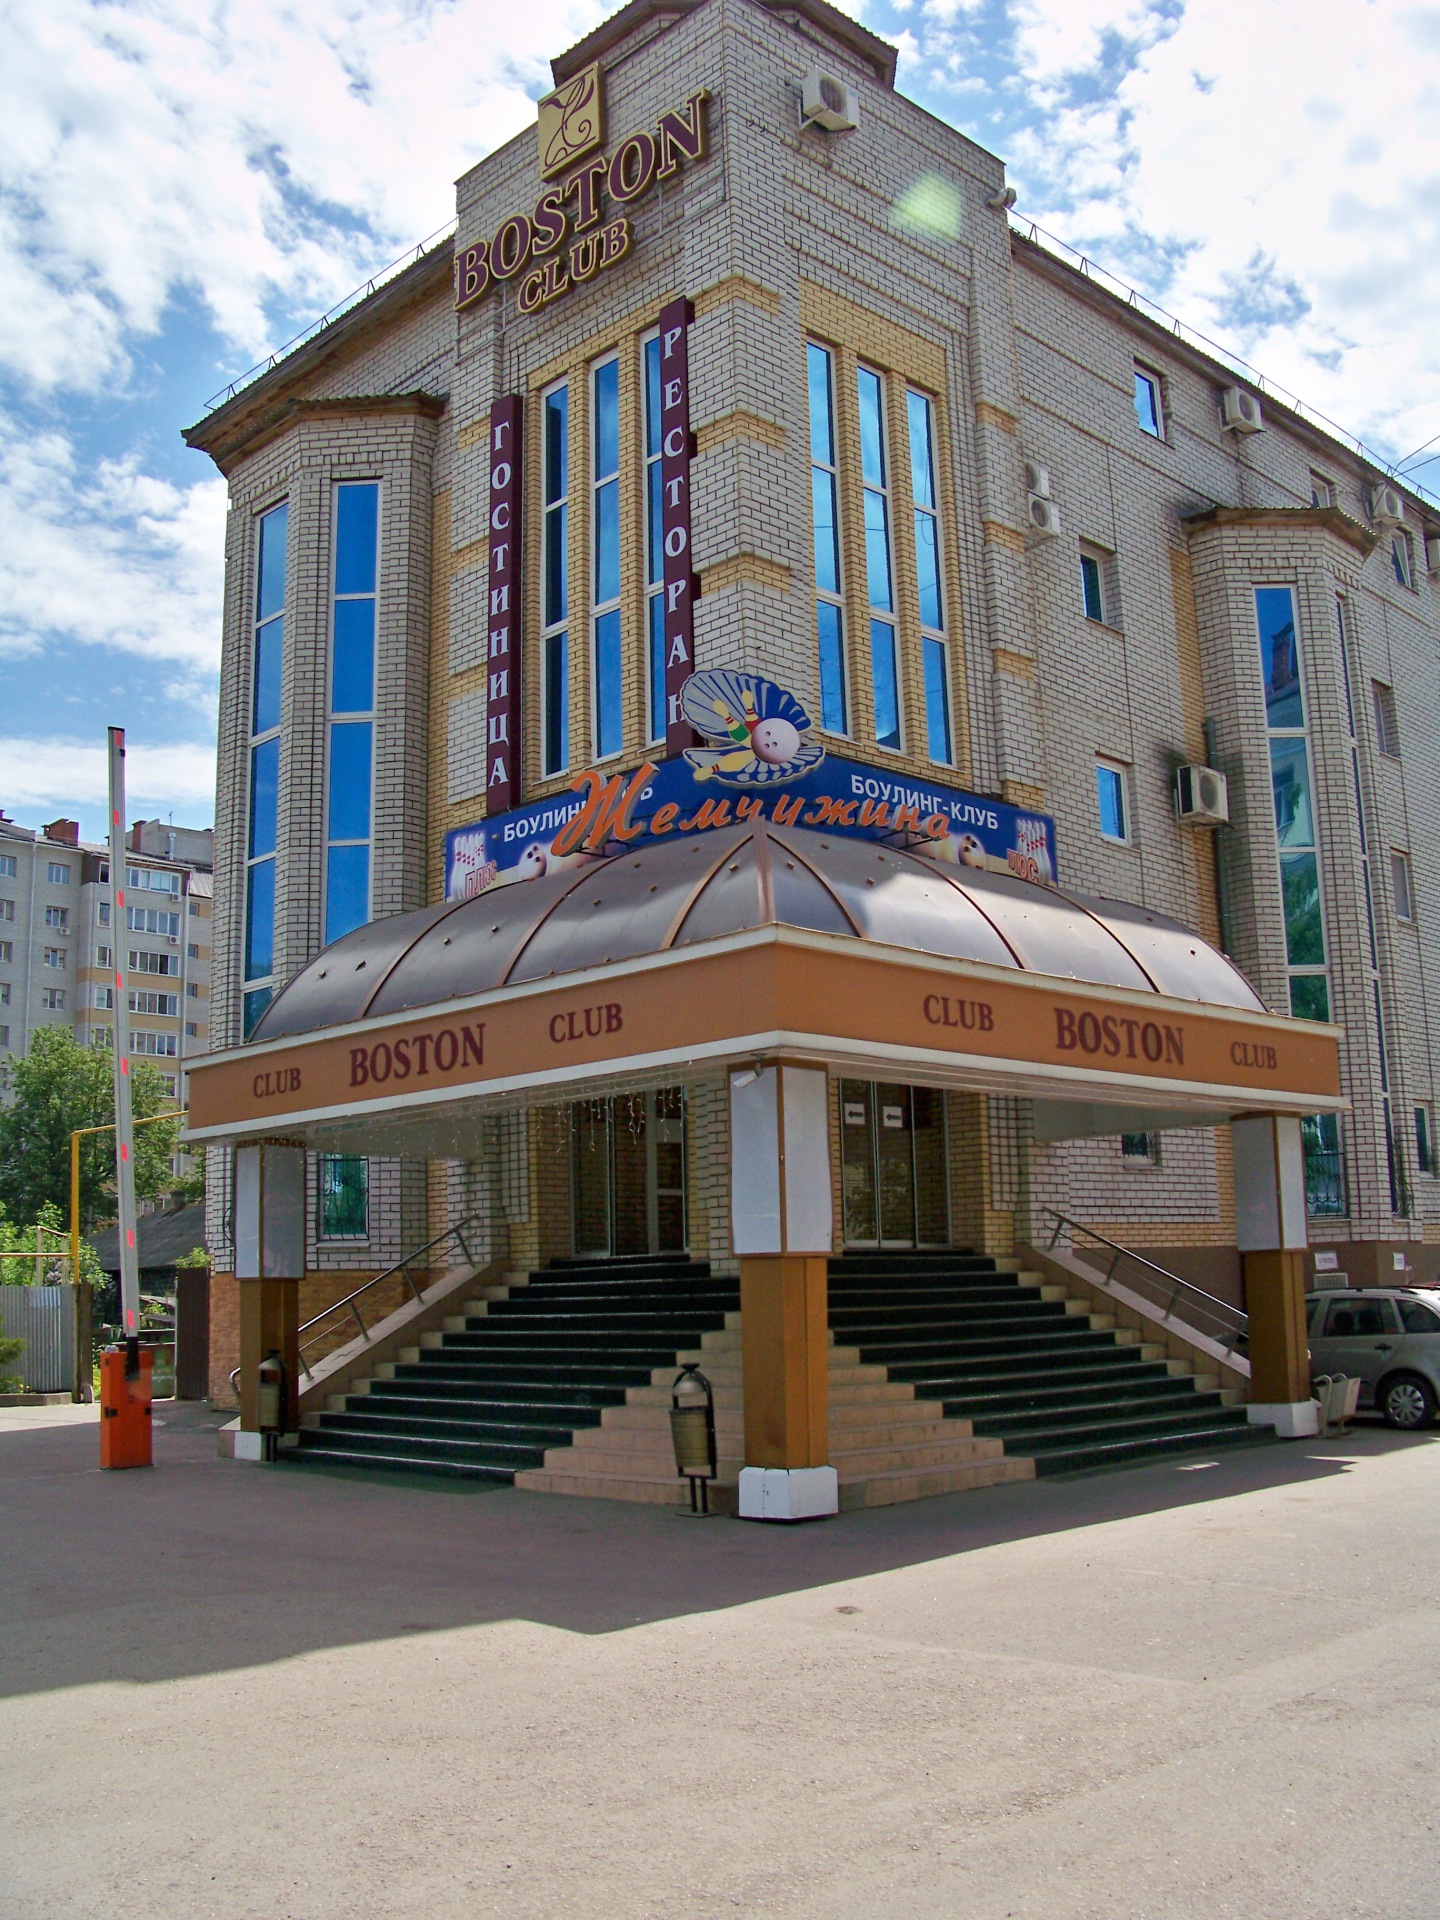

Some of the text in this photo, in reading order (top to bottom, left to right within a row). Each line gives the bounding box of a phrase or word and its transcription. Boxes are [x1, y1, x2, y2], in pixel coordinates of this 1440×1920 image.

[453, 88, 711, 312] BOSTON
[517, 217, 633, 314] CLUB
[487, 421, 512, 788] ГОСТИНИЦА
[851, 774, 999, 830] БОУЛИНГ-КЛУБ
[253, 1002, 624, 1098] CLUB BOSTON CLUB
[923, 994, 1278, 1070] CLUB BOSTON CLUB
